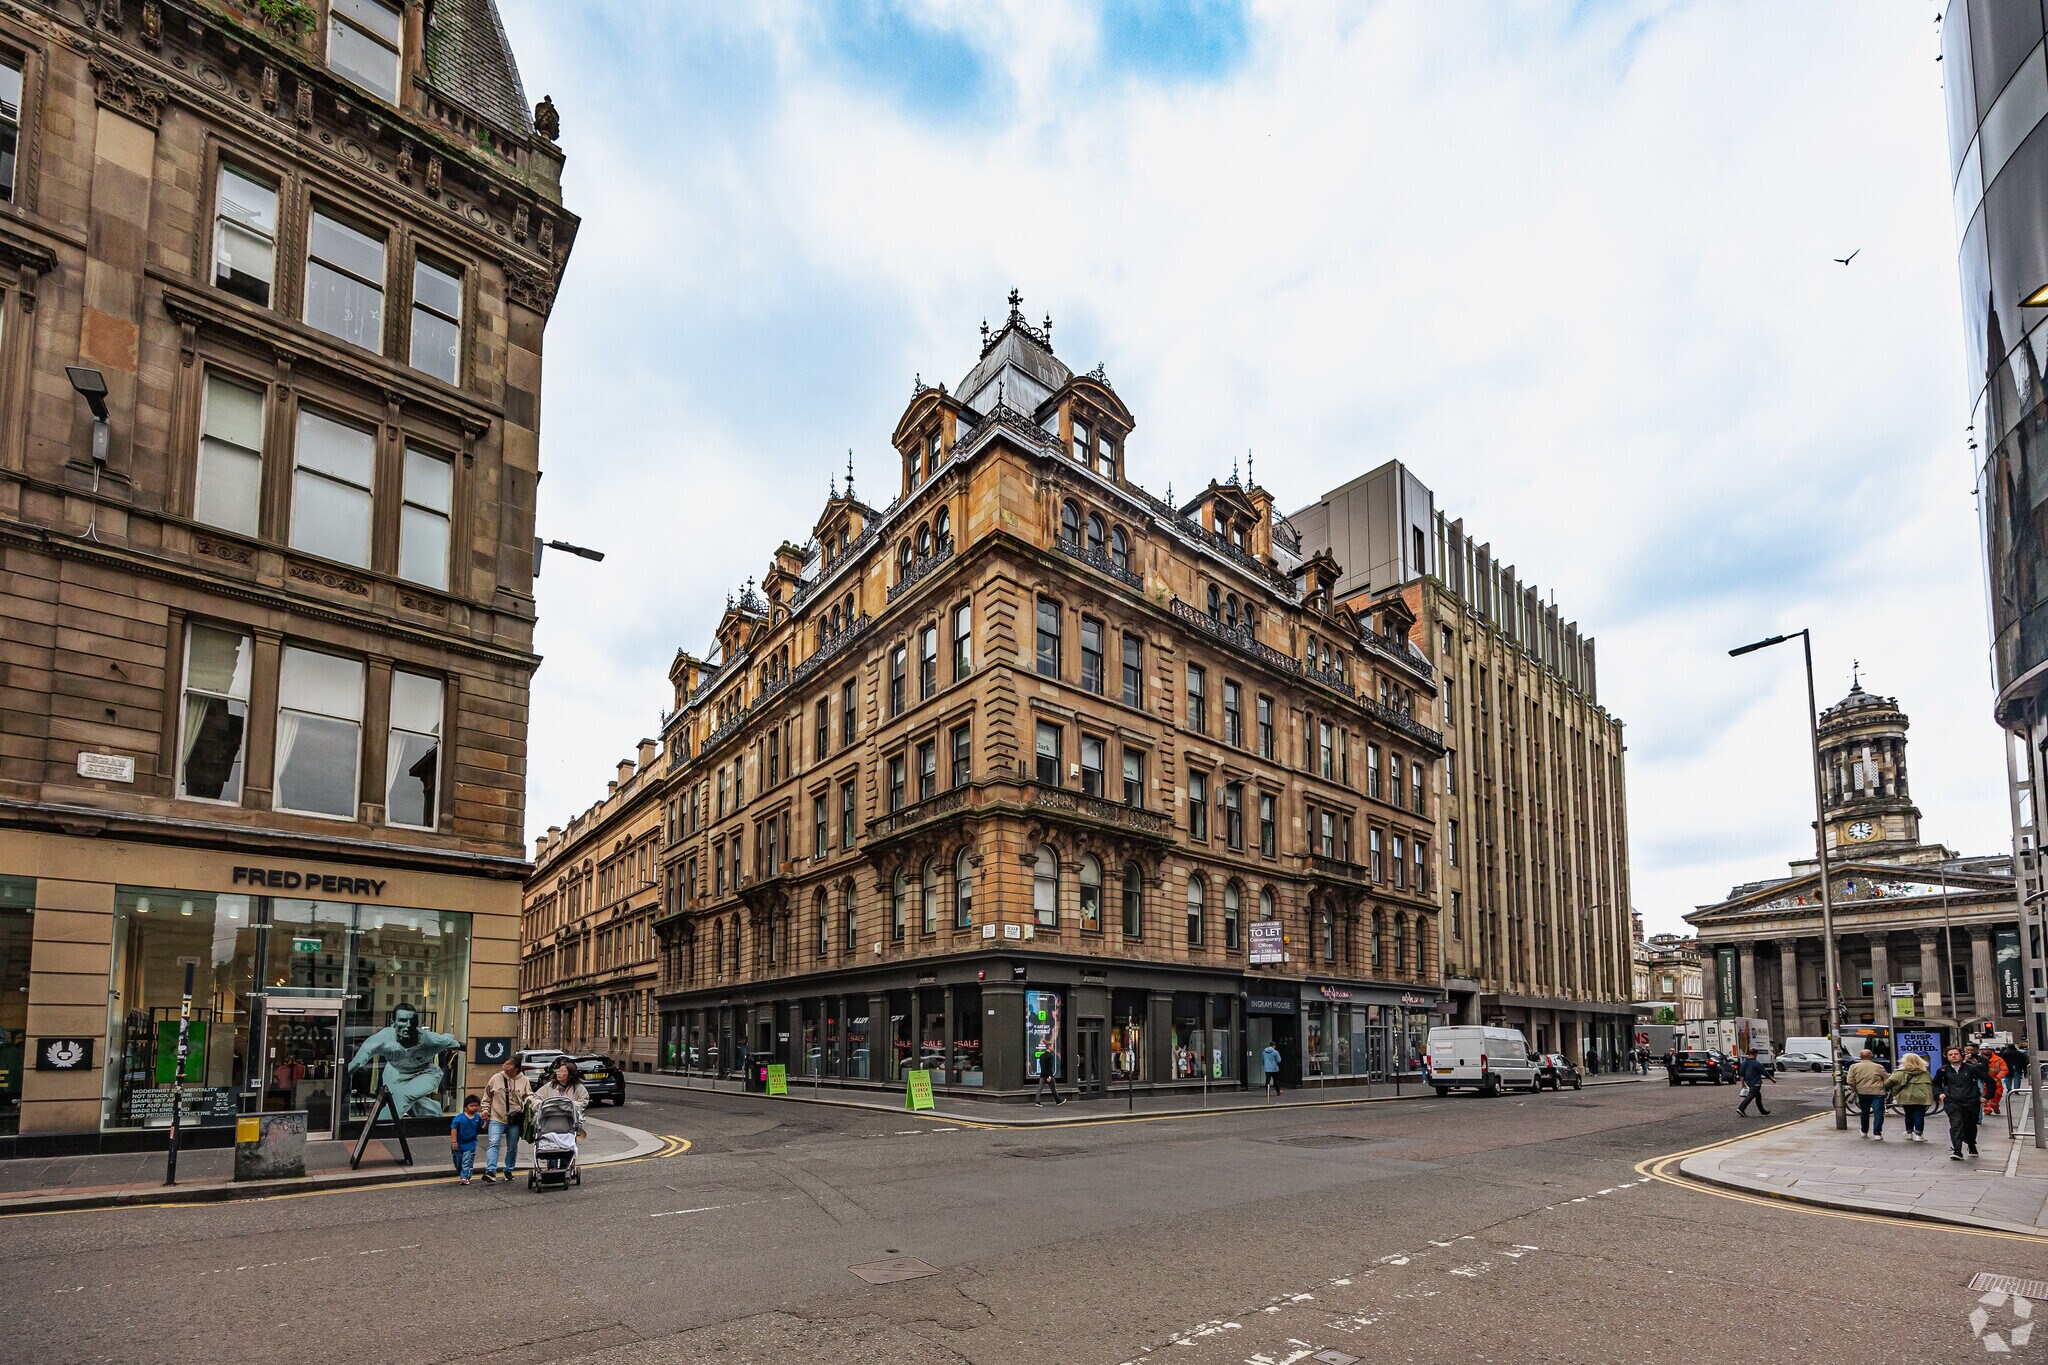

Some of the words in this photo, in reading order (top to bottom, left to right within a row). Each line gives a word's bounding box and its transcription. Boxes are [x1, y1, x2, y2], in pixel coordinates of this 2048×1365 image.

[232, 866, 302, 889] FRED
[306, 873, 386, 896] PERRY
[1266, 928, 1281, 936] LET
[1728, 921, 1798, 932] GALLERY
[1856, 909, 1936, 922] MODERN
[1959, 904, 1998, 914] ART
